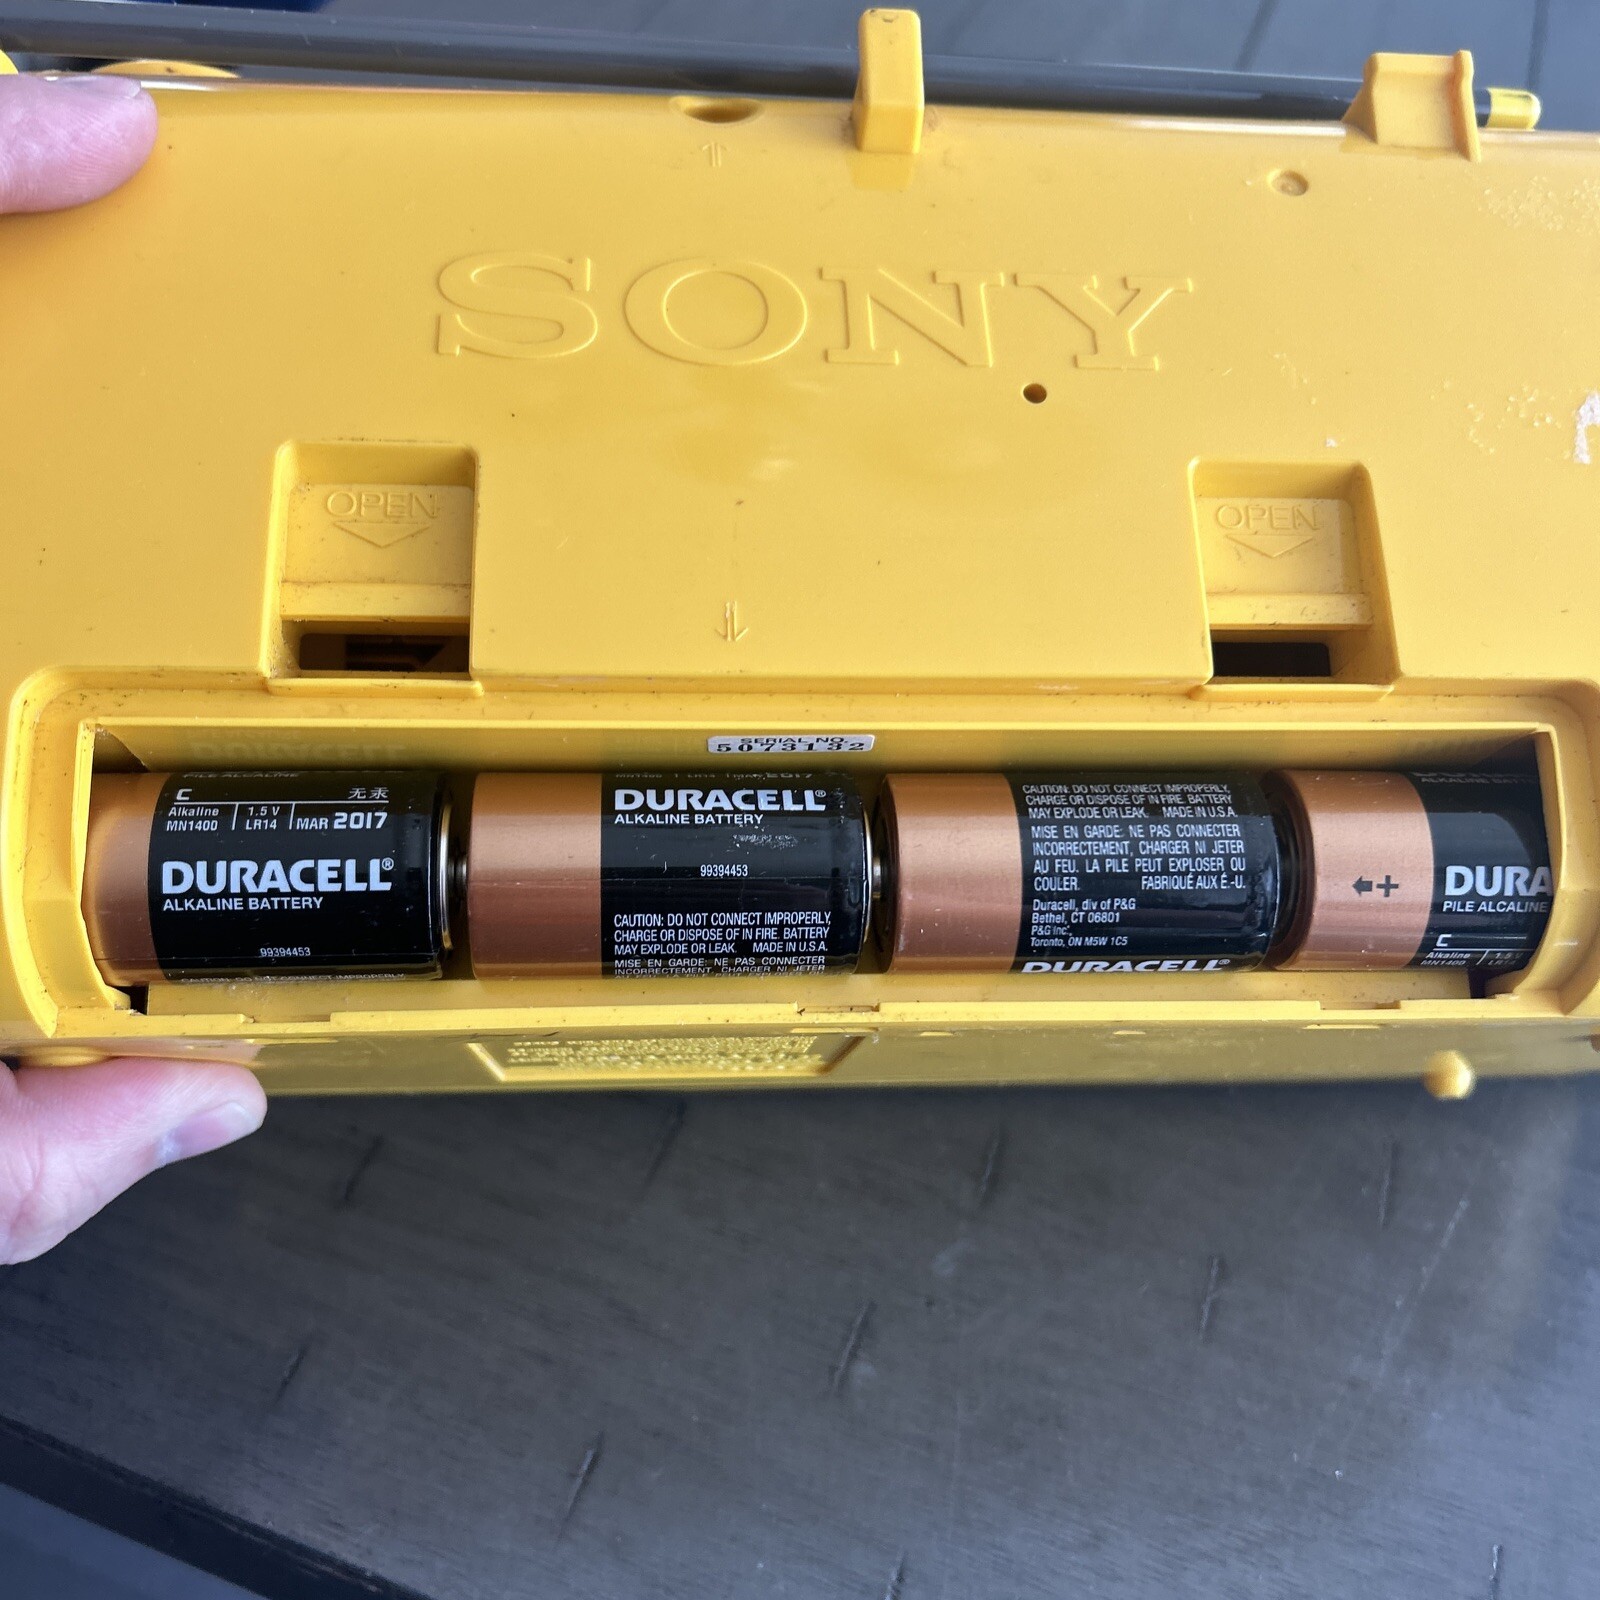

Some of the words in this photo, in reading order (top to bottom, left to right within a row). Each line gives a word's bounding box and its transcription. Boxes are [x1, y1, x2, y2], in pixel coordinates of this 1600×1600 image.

[436, 250, 1194, 371] SONY
[326, 490, 438, 519] OPEN
[1216, 504, 1320, 531] OPEN
[716, 742, 865, 752] 5073132
[176, 788, 193, 800] C
[1023, 785, 1069, 794] CAUTION:
[1072, 785, 1087, 793] DO
[1090, 785, 1111, 793] NOT
[1114, 785, 1162, 793] CONNECT
[1026, 796, 1066, 805] CHARGE
[1069, 796, 1084, 805] OR
[1087, 795, 1130, 804] DISPOSE
[1132, 795, 1146, 804] OF
[1148, 795, 1160, 804] IN
[1189, 794, 1232, 803] BATTERY
[168, 806, 219, 817] Alkaline
[249, 806, 267, 816] 1.5
[272, 806, 280, 816] V
[1029, 808, 1050, 819] MAY
[1053, 808, 1100, 818] EXPLODE
[1102, 808, 1118, 818] OR
[1162, 807, 1194, 817] MADE
[1195, 807, 1206, 817] IN
[1208, 806, 1238, 817] U.S.A.
[166, 819, 218, 831] MN1400
[245, 819, 277, 831] LR14
[296, 818, 328, 830] MAR
[333, 812, 388, 829] 2017
[614, 813, 690, 824] ALKALINE
[694, 813, 764, 824] BATTERY
[1031, 826, 1057, 838] MISE
[1064, 826, 1078, 838] EN
[1129, 825, 1144, 837] NE
[1150, 825, 1171, 837] PAS
[1176, 824, 1241, 837] CONNECTER
[1139, 841, 1189, 854] CHARGER
[1195, 841, 1206, 853] NI
[1212, 841, 1244, 854] JETER
[700, 864, 748, 877] 99394453
[1034, 860, 1049, 874] AU
[1055, 859, 1079, 873] FEU.
[1086, 859, 1100, 873] LA
[1105, 859, 1129, 872] PILE
[1135, 858, 1162, 872] PEUT
[1169, 858, 1224, 872] EXPLOSER
[1230, 858, 1246, 871] OU
[1034, 877, 1080, 891] COULER.
[1142, 873, 1193, 890] FABRIQUÉ
[1195, 876, 1217, 889] AUX
[163, 897, 243, 911] ALKALINE
[248, 896, 323, 911] BATTERY
[1033, 899, 1078, 912] Duracell,
[1082, 899, 1097, 910] div
[1100, 899, 1111, 910] of
[1114, 898, 1136, 910] P&G
[1443, 901, 1474, 912] PILE
[1477, 901, 1548, 912] ALCALINE
[614, 914, 663, 927] CAUTION:
[667, 913, 683, 926] DO
[686, 913, 708, 926] NOT
[711, 912, 762, 926] CONNECT
[765, 911, 831, 927] IMPROPERLY,
[1032, 913, 1067, 924] Bethel,
[1071, 912, 1085, 923] CT
[1088, 912, 1120, 923] 06801
[614, 930, 657, 942] CHARGE
[660, 930, 675, 941] OR
[678, 929, 723, 940] DISPOSE
[726, 928, 739, 940] OF
[742, 928, 752, 939] IN
[783, 927, 829, 939] BATTERY
[1031, 926, 1051, 935] P&G
[1031, 937, 1065, 947] Toronto,
[1068, 937, 1082, 946] ON
[1084, 937, 1108, 945] M5W
[1111, 937, 1128, 945] 1C5
[1436, 934, 1452, 947] C
[260, 947, 310, 957] 99394453
[615, 945, 638, 955] MAY
[641, 944, 688, 954] EXPLODE
[691, 944, 706, 953] OR
[753, 942, 783, 952] MADE
[786, 942, 796, 952] IN
[799, 941, 828, 952] U.S.A.
[615, 960, 641, 968] MISE
[648, 959, 662, 967] EN
[668, 958, 707, 967] GARDE:
[714, 958, 728, 966] NE
[735, 957, 756, 965] PAS
[762, 956, 825, 965] CONNECTER
